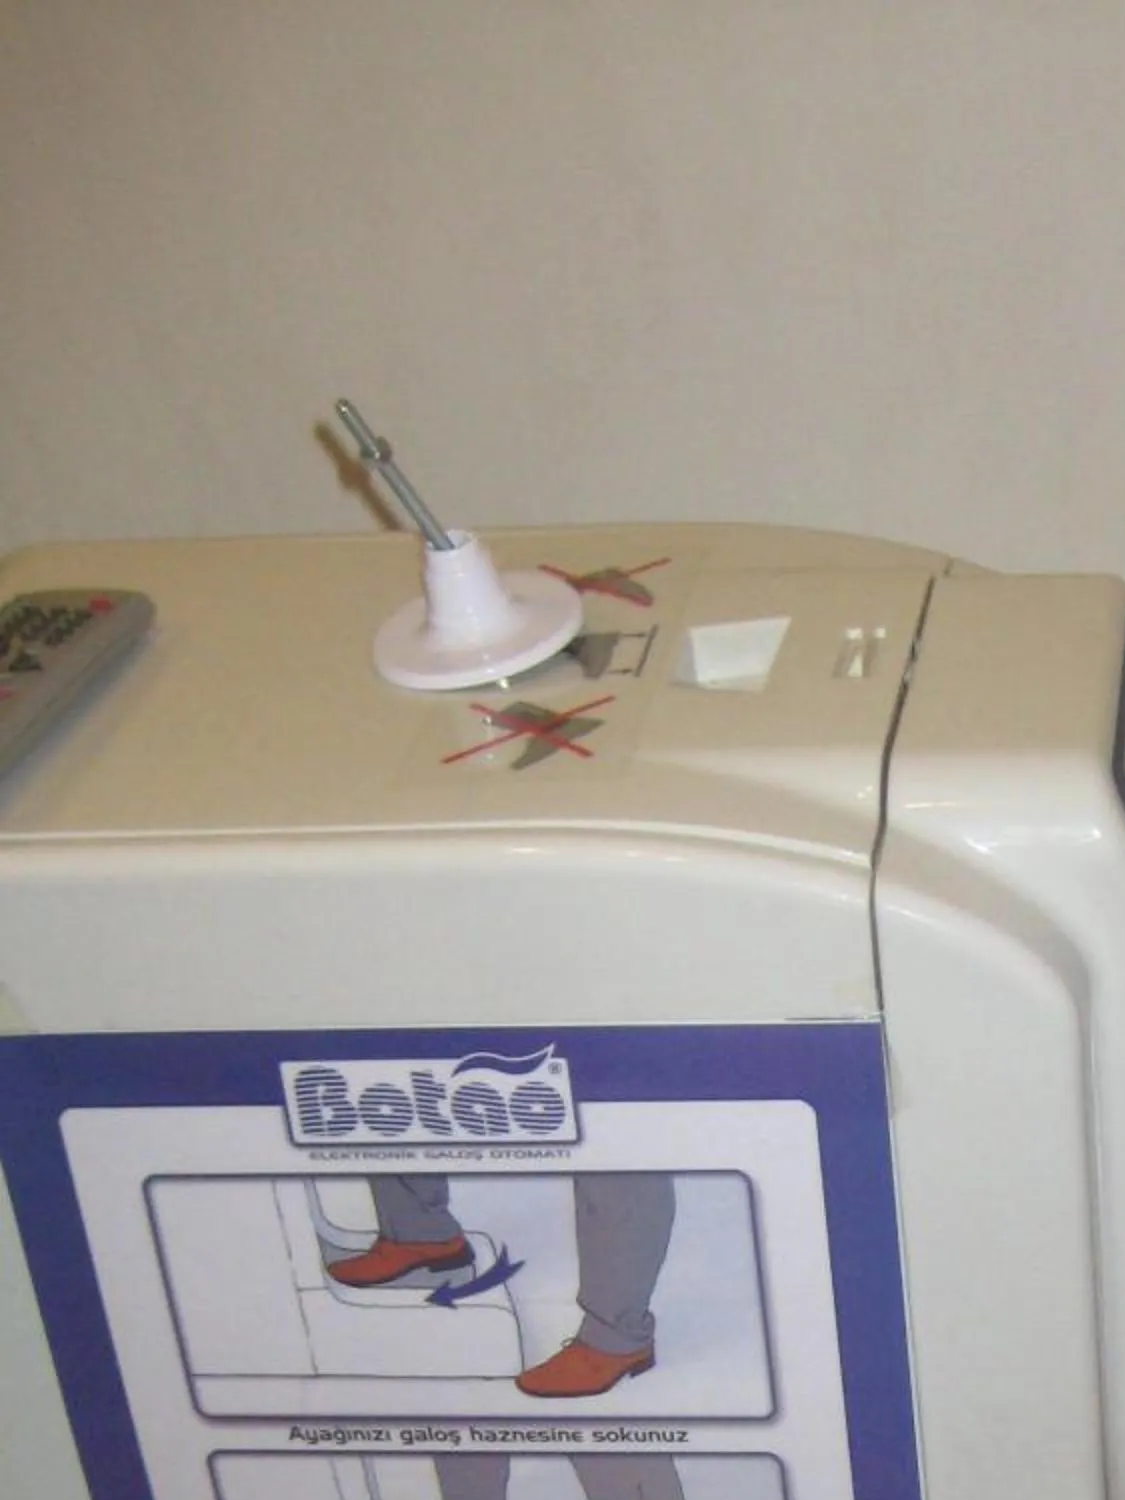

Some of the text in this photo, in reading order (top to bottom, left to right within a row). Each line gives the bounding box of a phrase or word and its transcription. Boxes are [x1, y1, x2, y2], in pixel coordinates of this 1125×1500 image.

[288, 1425, 689, 1446] Ayağınızı galoş haznesine sokunuz
